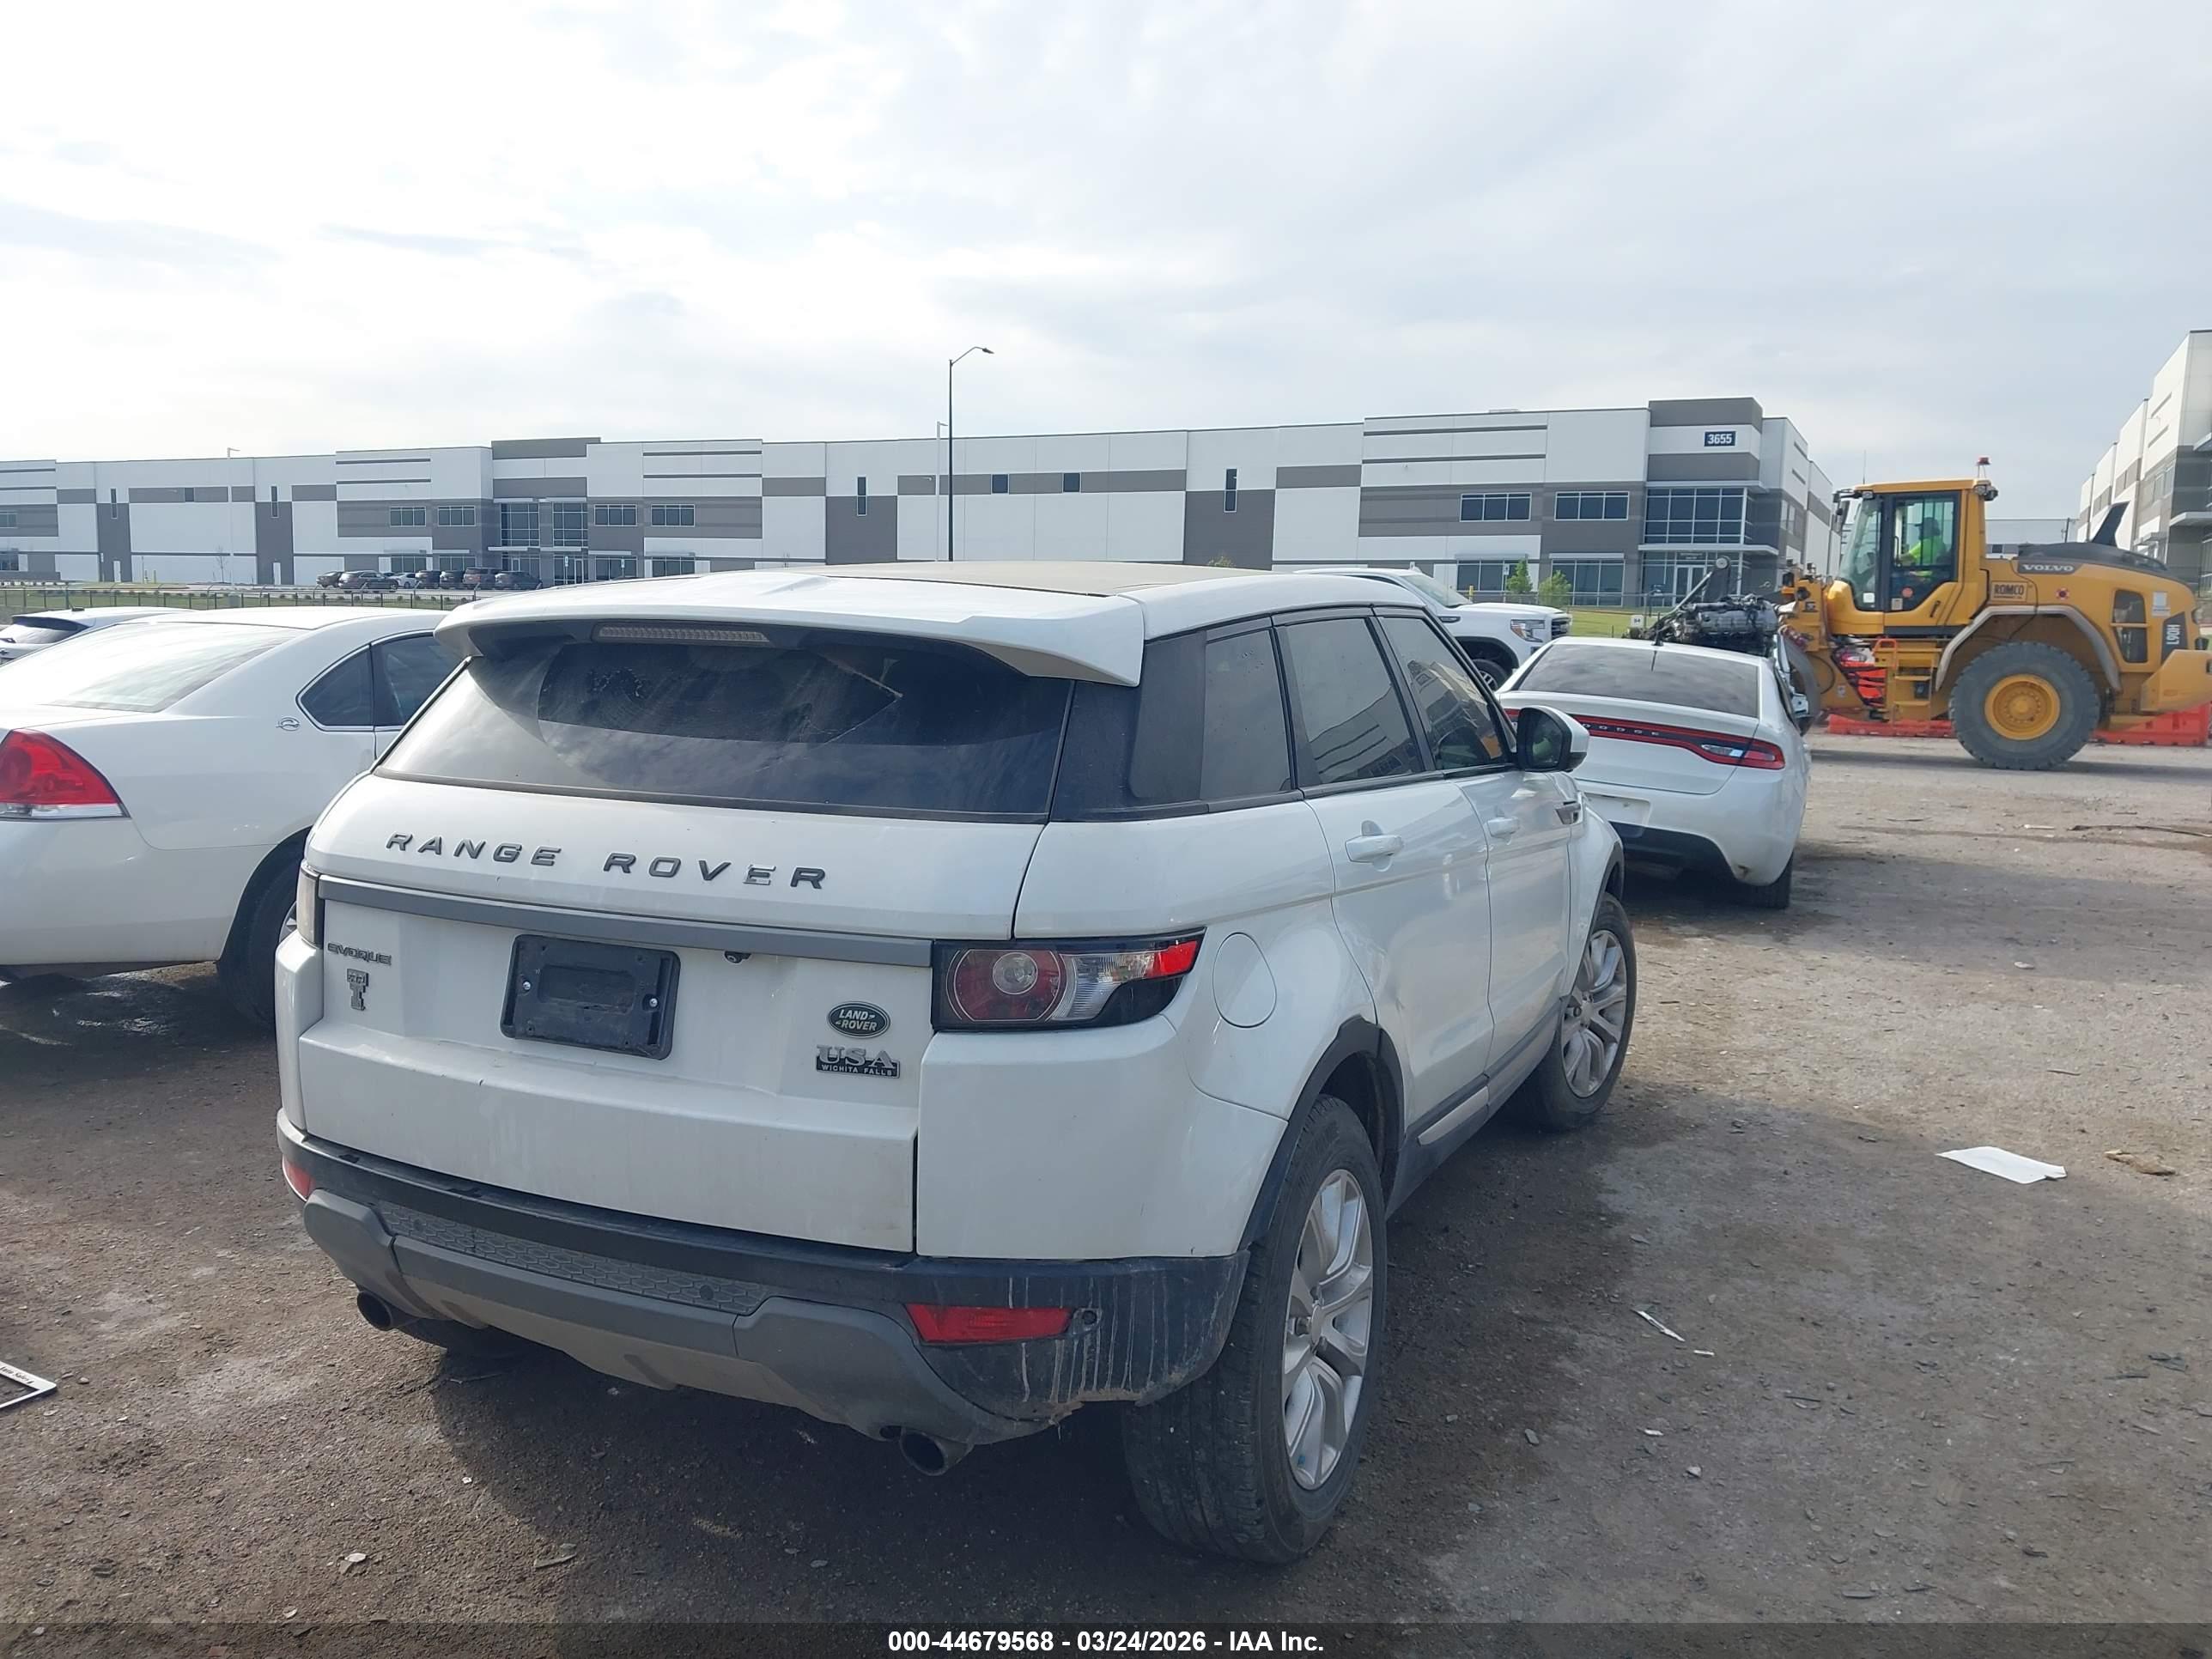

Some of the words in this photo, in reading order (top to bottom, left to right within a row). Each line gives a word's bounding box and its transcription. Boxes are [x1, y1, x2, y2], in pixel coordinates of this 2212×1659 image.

[1707, 433, 1733, 445] 3655
[2022, 563, 2075, 572] VOLVO
[2166, 624, 2181, 645] L90H
[1582, 723, 1660, 736] DODGE
[386, 831, 562, 866] RANGE
[603, 852, 826, 890] ROVER
[327, 943, 392, 966] EVOQUE
[839, 1009, 869, 1020] LAND
[841, 1019, 878, 1031] ROVER
[816, 1044, 896, 1069] USA
[821, 1064, 859, 1073] WICHITA
[864, 1067, 892, 1076] FALLS
